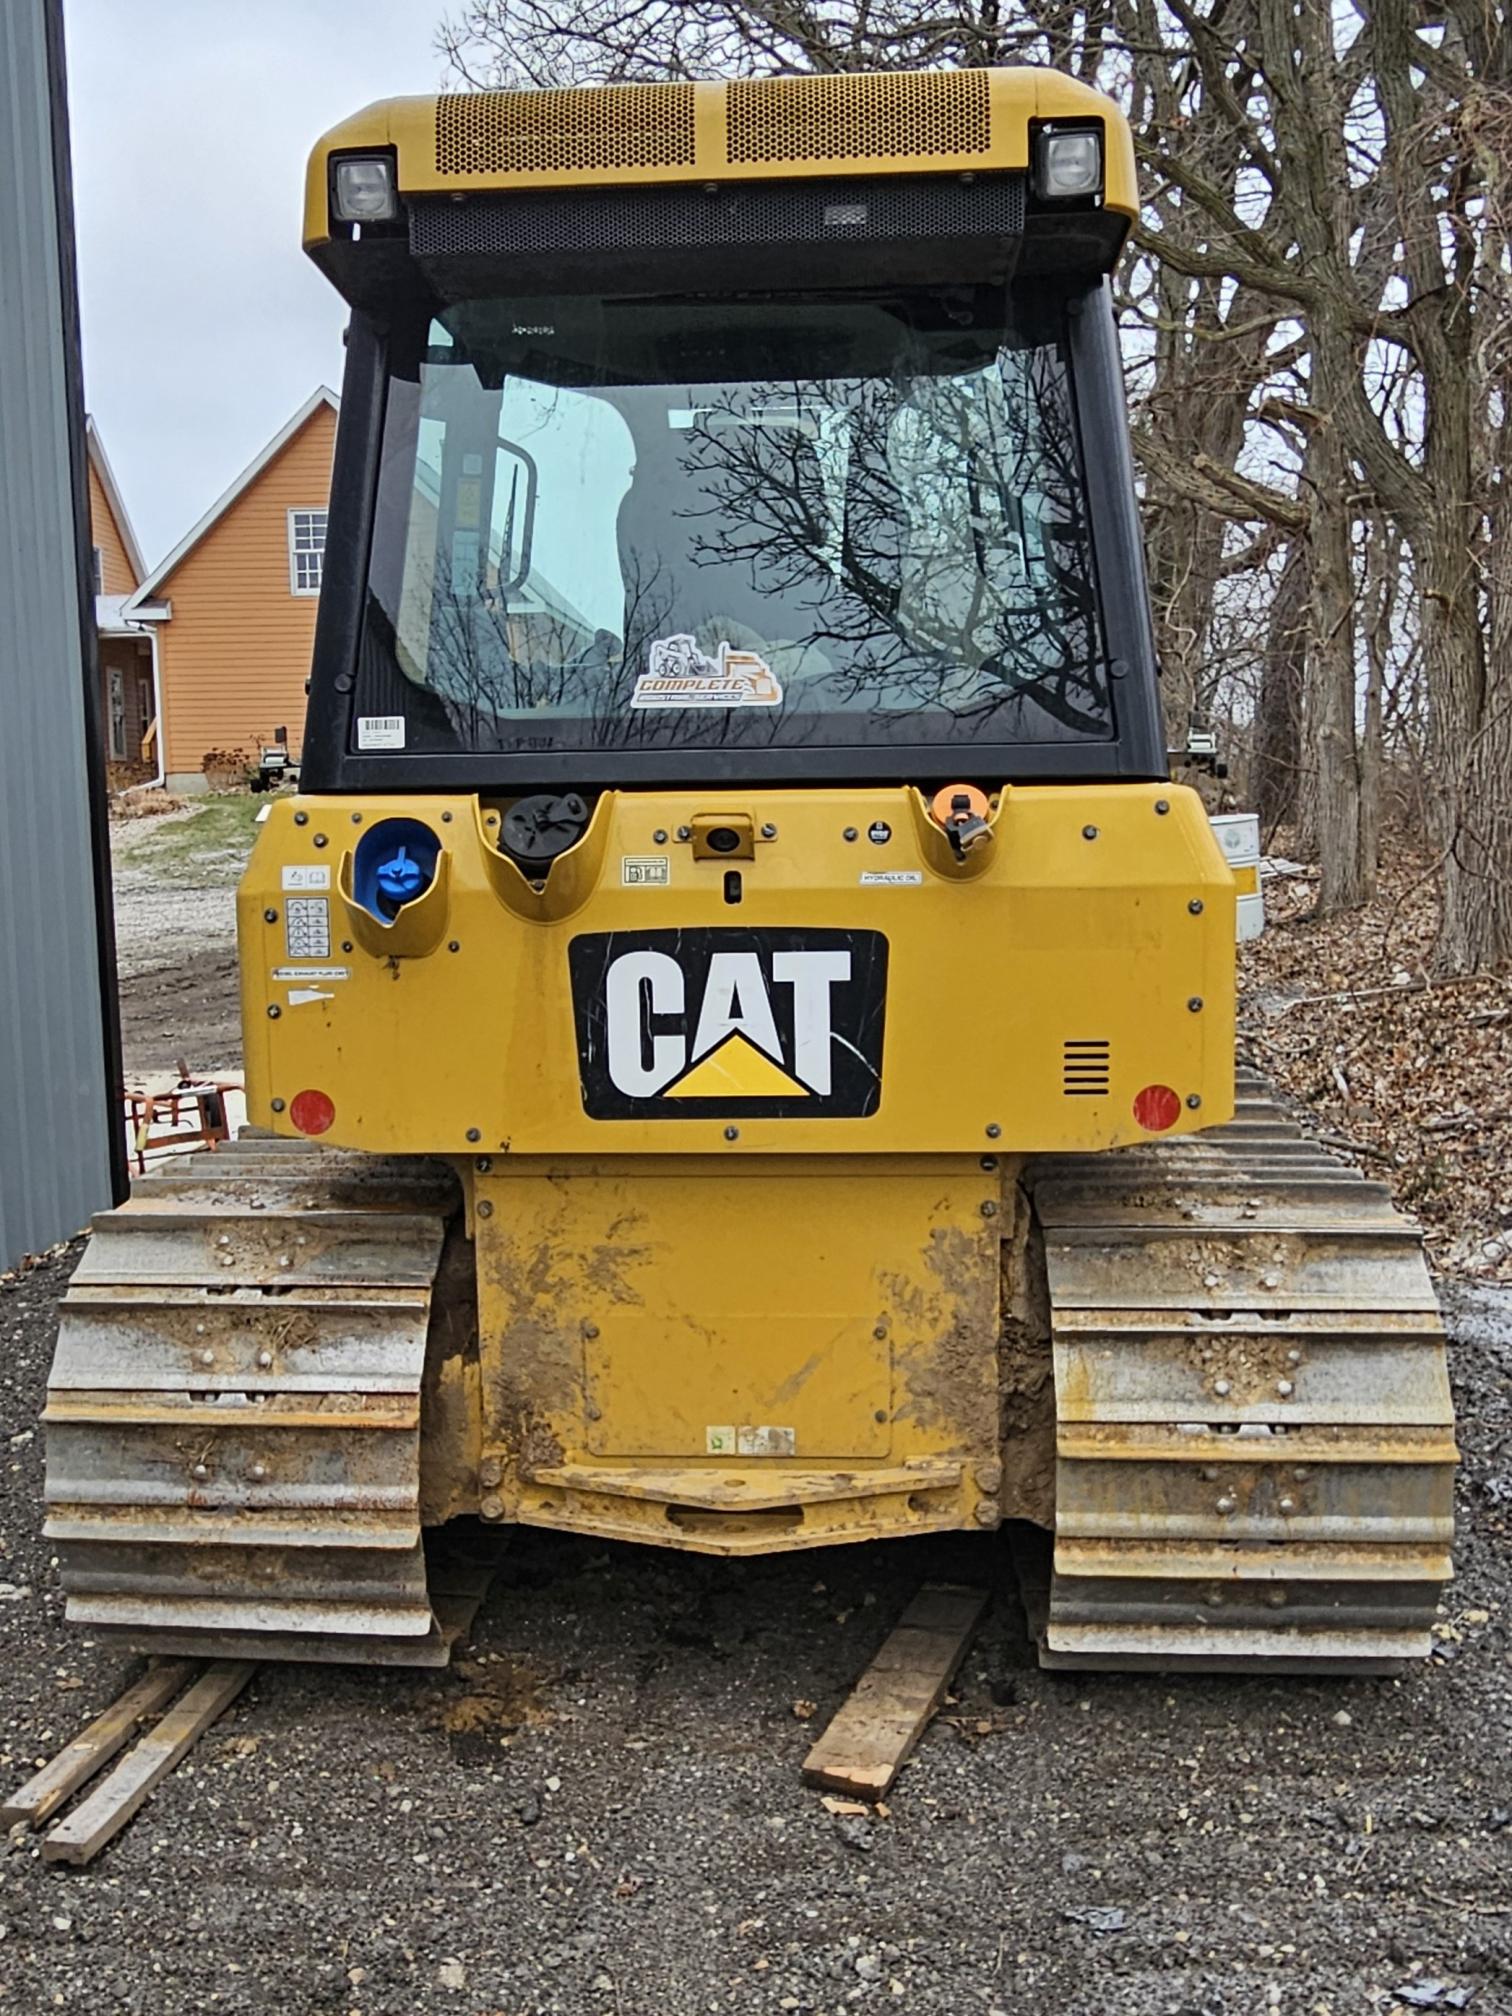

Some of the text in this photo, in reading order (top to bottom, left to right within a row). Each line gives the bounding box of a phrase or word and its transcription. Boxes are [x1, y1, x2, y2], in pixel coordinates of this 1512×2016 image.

[640, 679, 744, 691] COMPLETE
[864, 874, 904, 882] HYDRAULIC
[606, 950, 851, 1098] CAT
